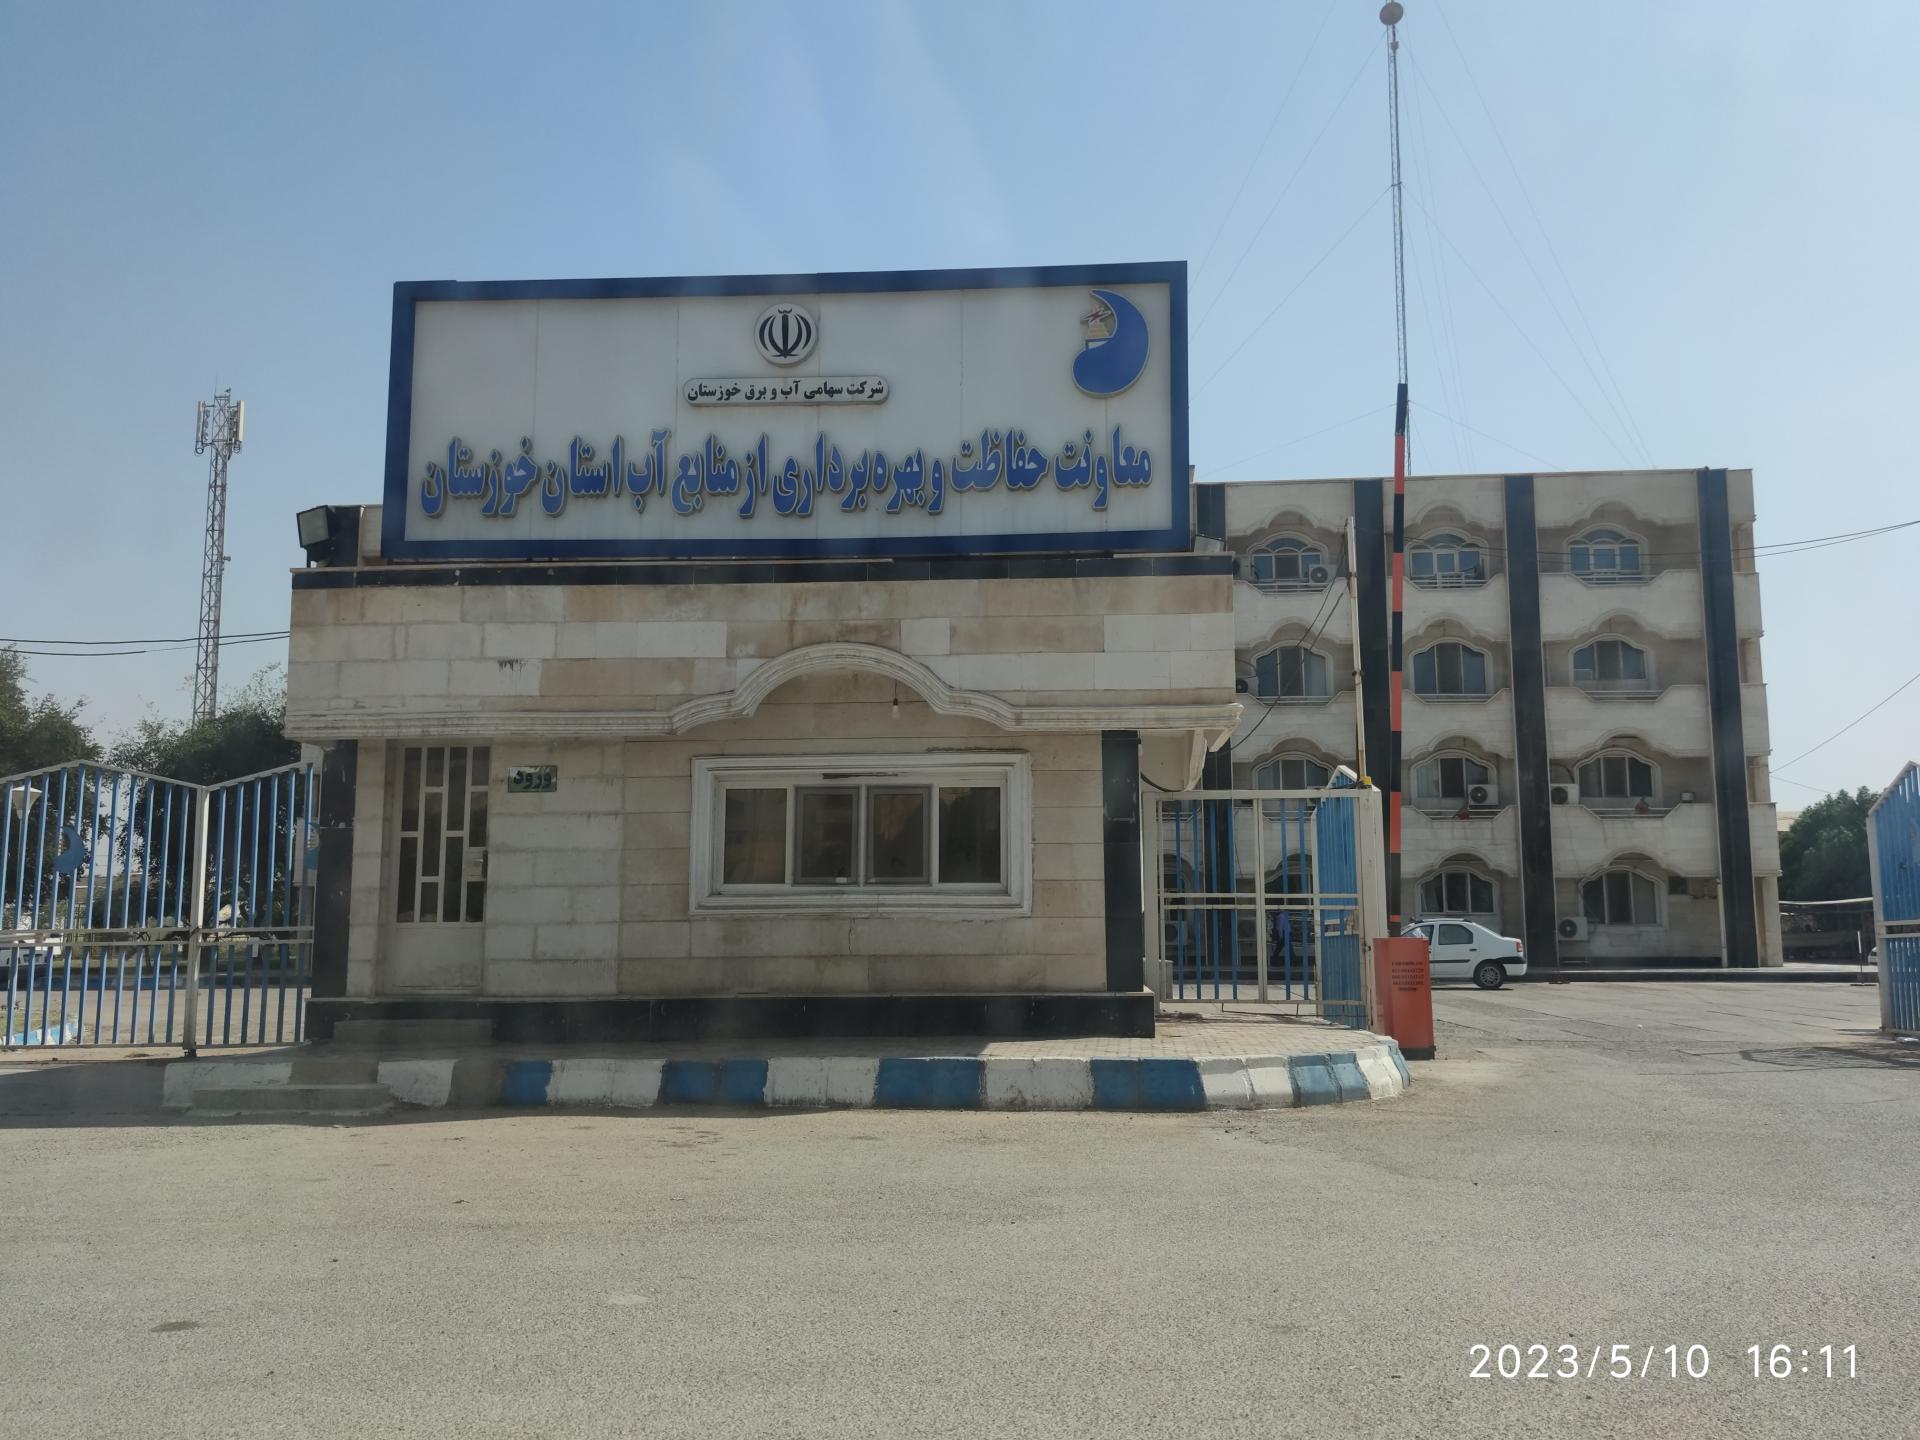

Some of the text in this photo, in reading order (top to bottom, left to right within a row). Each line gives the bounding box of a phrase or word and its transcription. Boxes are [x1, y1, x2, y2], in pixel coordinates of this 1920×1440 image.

[687, 379, 885, 401] شرکت سهامی آب و برق خوزستان
[420, 435, 542, 518] خوزستان
[540, 434, 624, 518] استان
[625, 428, 672, 516] آب
[671, 432, 740, 516] منابع
[738, 431, 769, 519] از
[926, 457, 946, 515] و
[950, 425, 1050, 492] حفاظت
[1053, 422, 1154, 512] معاونت
[513, 769, 552, 790] ورود
